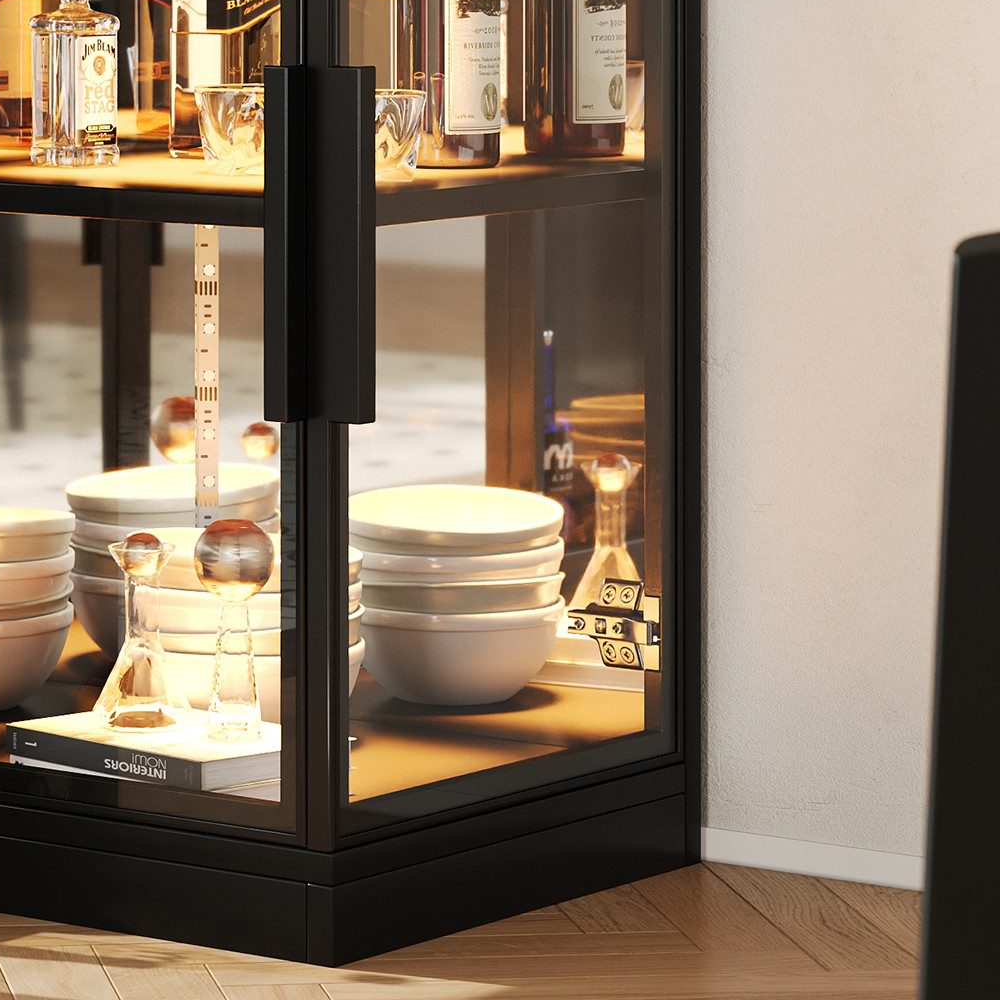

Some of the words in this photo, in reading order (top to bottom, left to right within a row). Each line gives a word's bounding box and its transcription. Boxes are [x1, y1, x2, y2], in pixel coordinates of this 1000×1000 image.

[81, 42, 96, 61] JIM
[96, 38, 116, 58] BEAM
[463, 41, 492, 49] RIVERSIDE
[84, 78, 115, 100] red
[84, 100, 115, 114] STAG
[104, 758, 167, 780] INTERIORS
